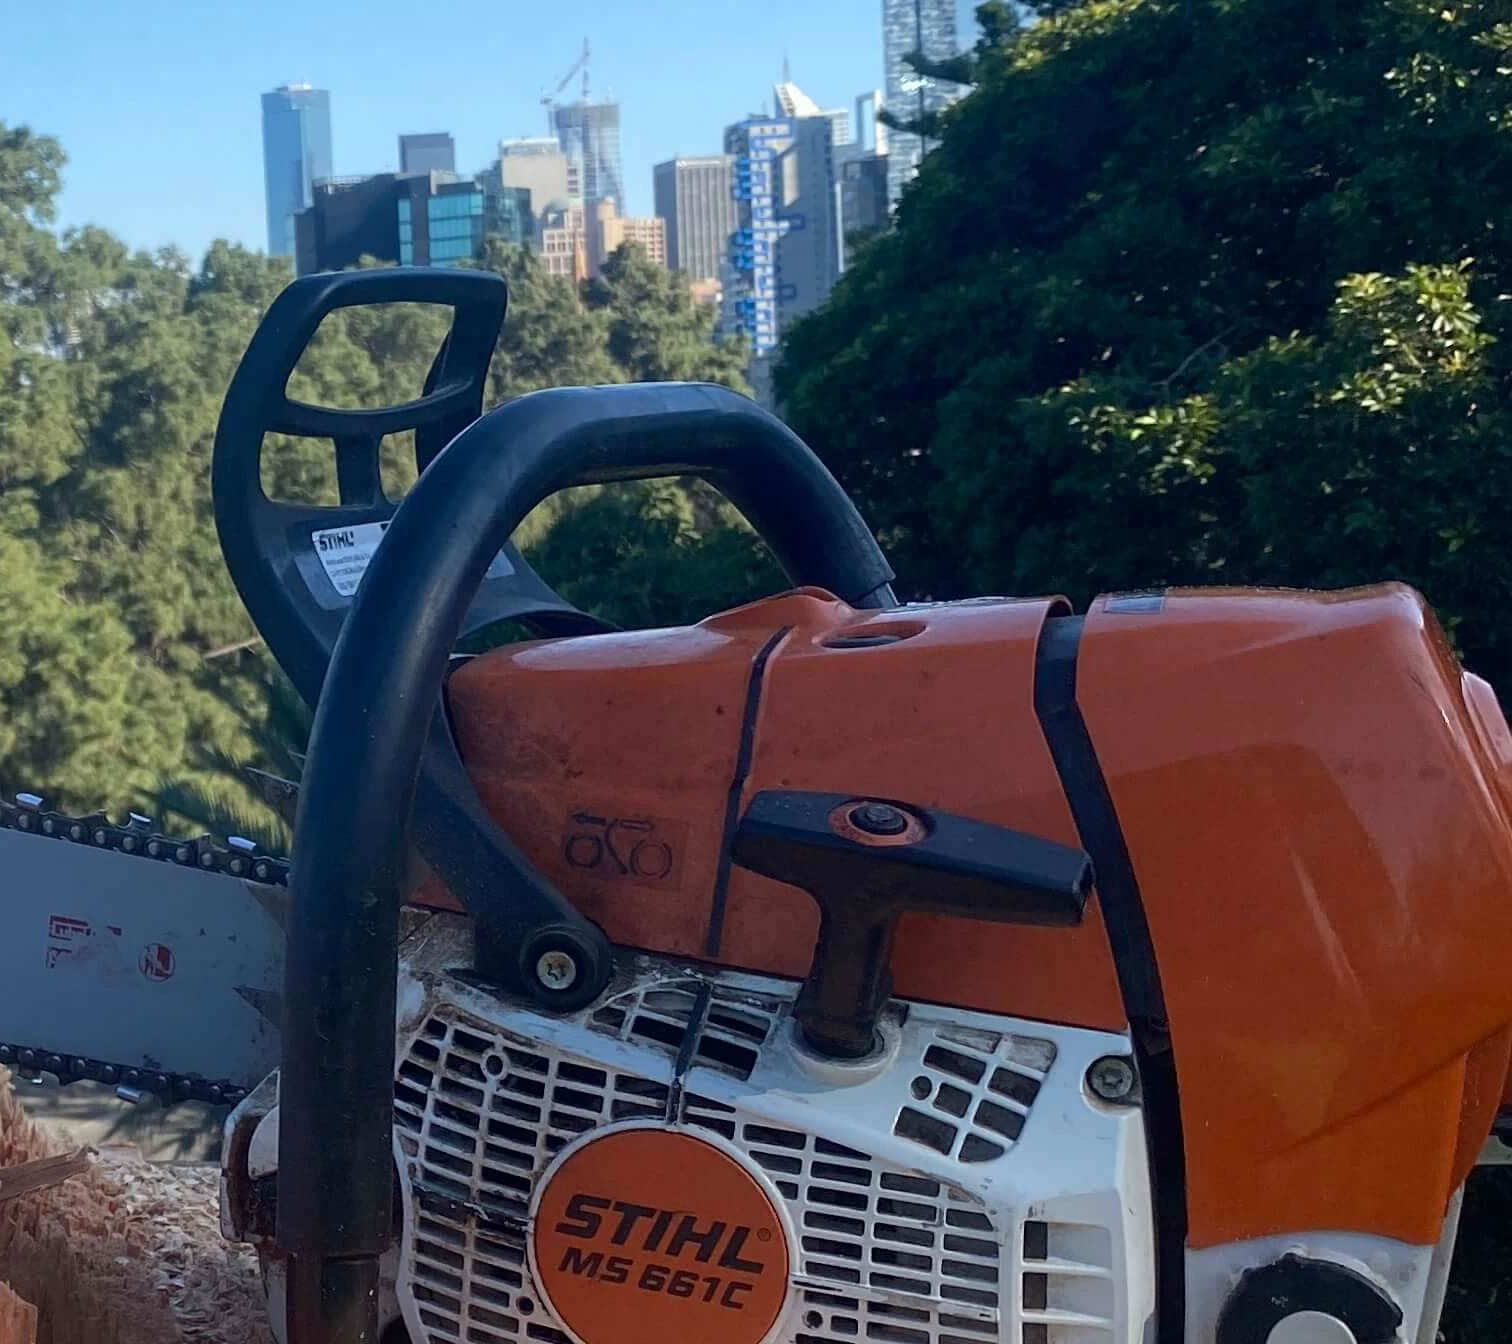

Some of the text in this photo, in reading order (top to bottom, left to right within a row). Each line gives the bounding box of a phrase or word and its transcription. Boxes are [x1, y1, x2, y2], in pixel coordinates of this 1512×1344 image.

[319, 531, 354, 551] STIHL
[554, 1193, 764, 1275] STIHL
[558, 1247, 754, 1310] MS 661C
